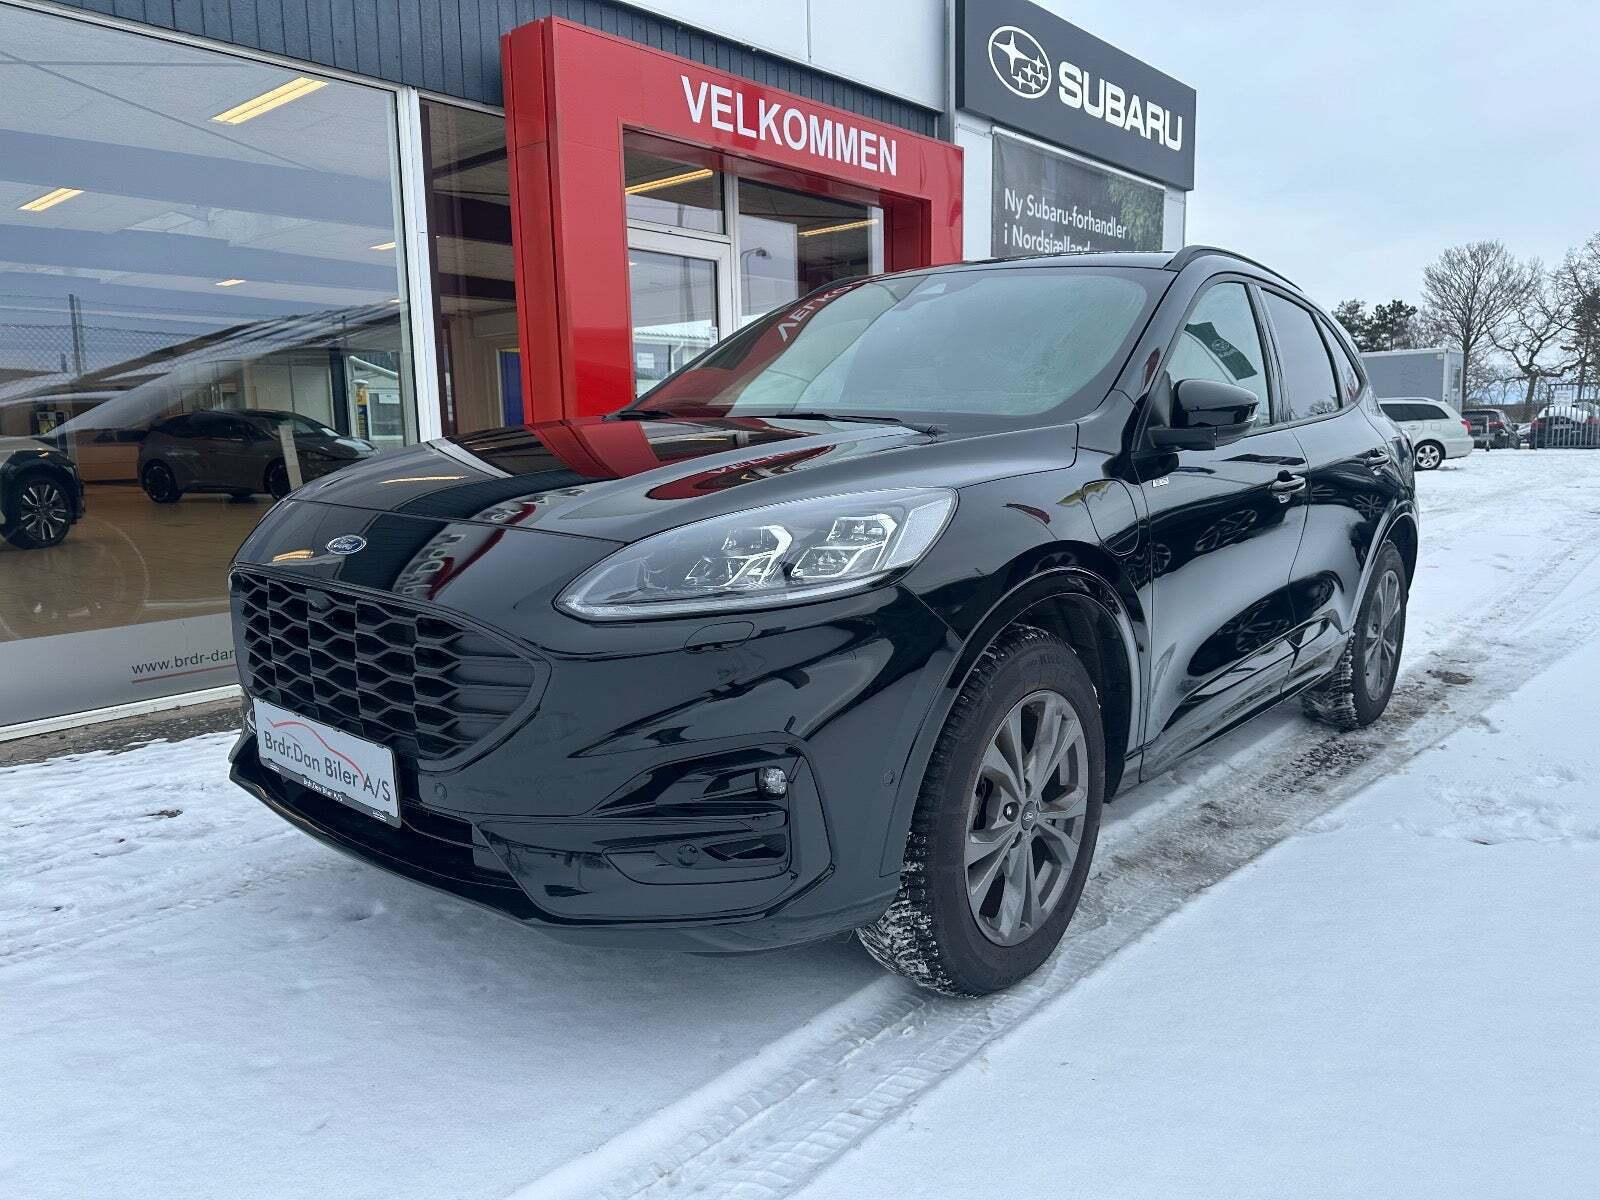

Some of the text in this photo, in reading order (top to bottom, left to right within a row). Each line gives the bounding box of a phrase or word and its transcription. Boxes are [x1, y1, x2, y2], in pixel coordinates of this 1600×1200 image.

[681, 75, 897, 177] VELKOMMEN
[1059, 61, 1182, 151] SUBARU
[1004, 187, 1127, 240] Ny Subaru-forhandler
[1004, 222, 1008, 245] i
[264, 730, 321, 773] Brdr.Dan
[324, 756, 359, 787] Biler
[363, 773, 391, 802] A/S
